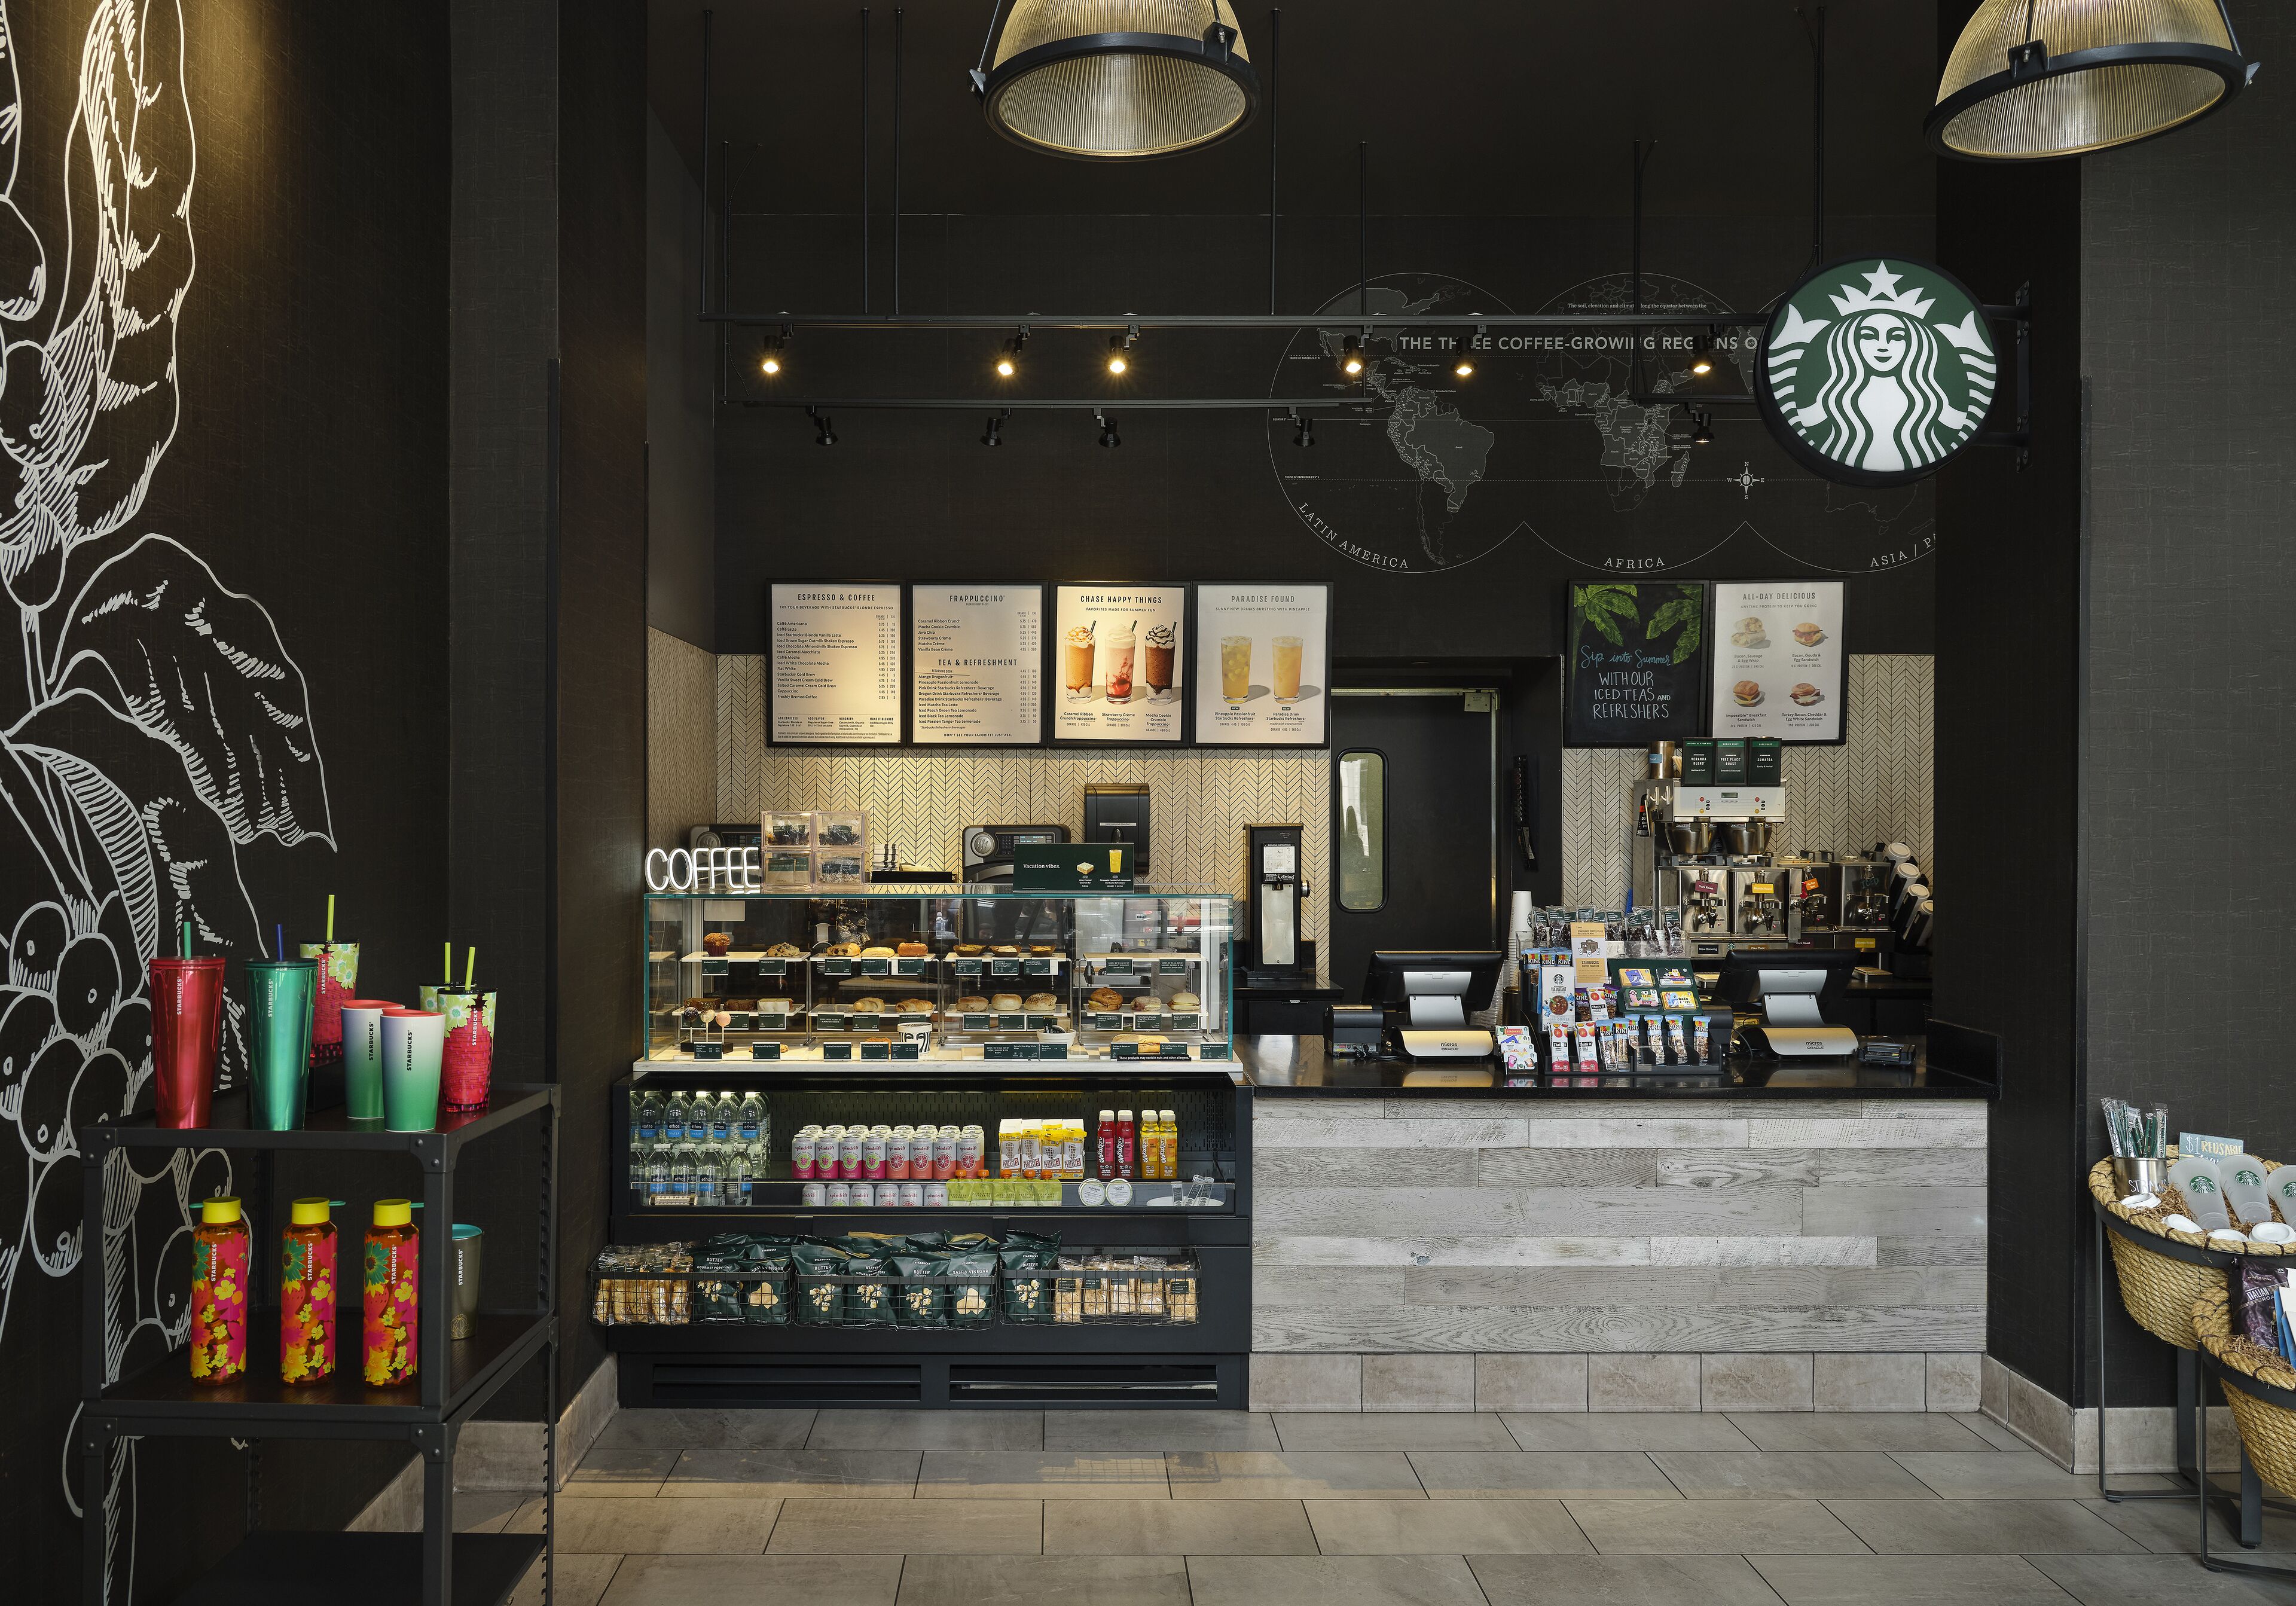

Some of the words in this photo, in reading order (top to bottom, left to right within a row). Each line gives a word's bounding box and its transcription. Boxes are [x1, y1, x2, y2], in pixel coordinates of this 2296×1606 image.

[1400, 337, 1431, 349] THE
[1438, 337, 1491, 349] THEE
[1663, 337, 1738, 350] REGNS
[1299, 502, 1338, 541] LATIN
[1339, 541, 1408, 569] AMERICA
[1604, 557, 1665, 569] AFRICA
[1870, 551, 1907, 567] ASIA
[1581, 645, 1604, 668] Sip
[1608, 652, 1632, 663] into
[1635, 649, 1671, 668] Summer
[1599, 671, 1628, 685] WITH
[1631, 671, 1654, 686] OUR
[1595, 688, 1620, 700] ICED
[1623, 688, 1654, 701] TEAS
[1593, 703, 1669, 719] REFRESHERS
[645, 847, 761, 891] COFFEE
[2185, 1134, 2200, 1155] $1
[2246, 1289, 2270, 1300] ITALIAN
